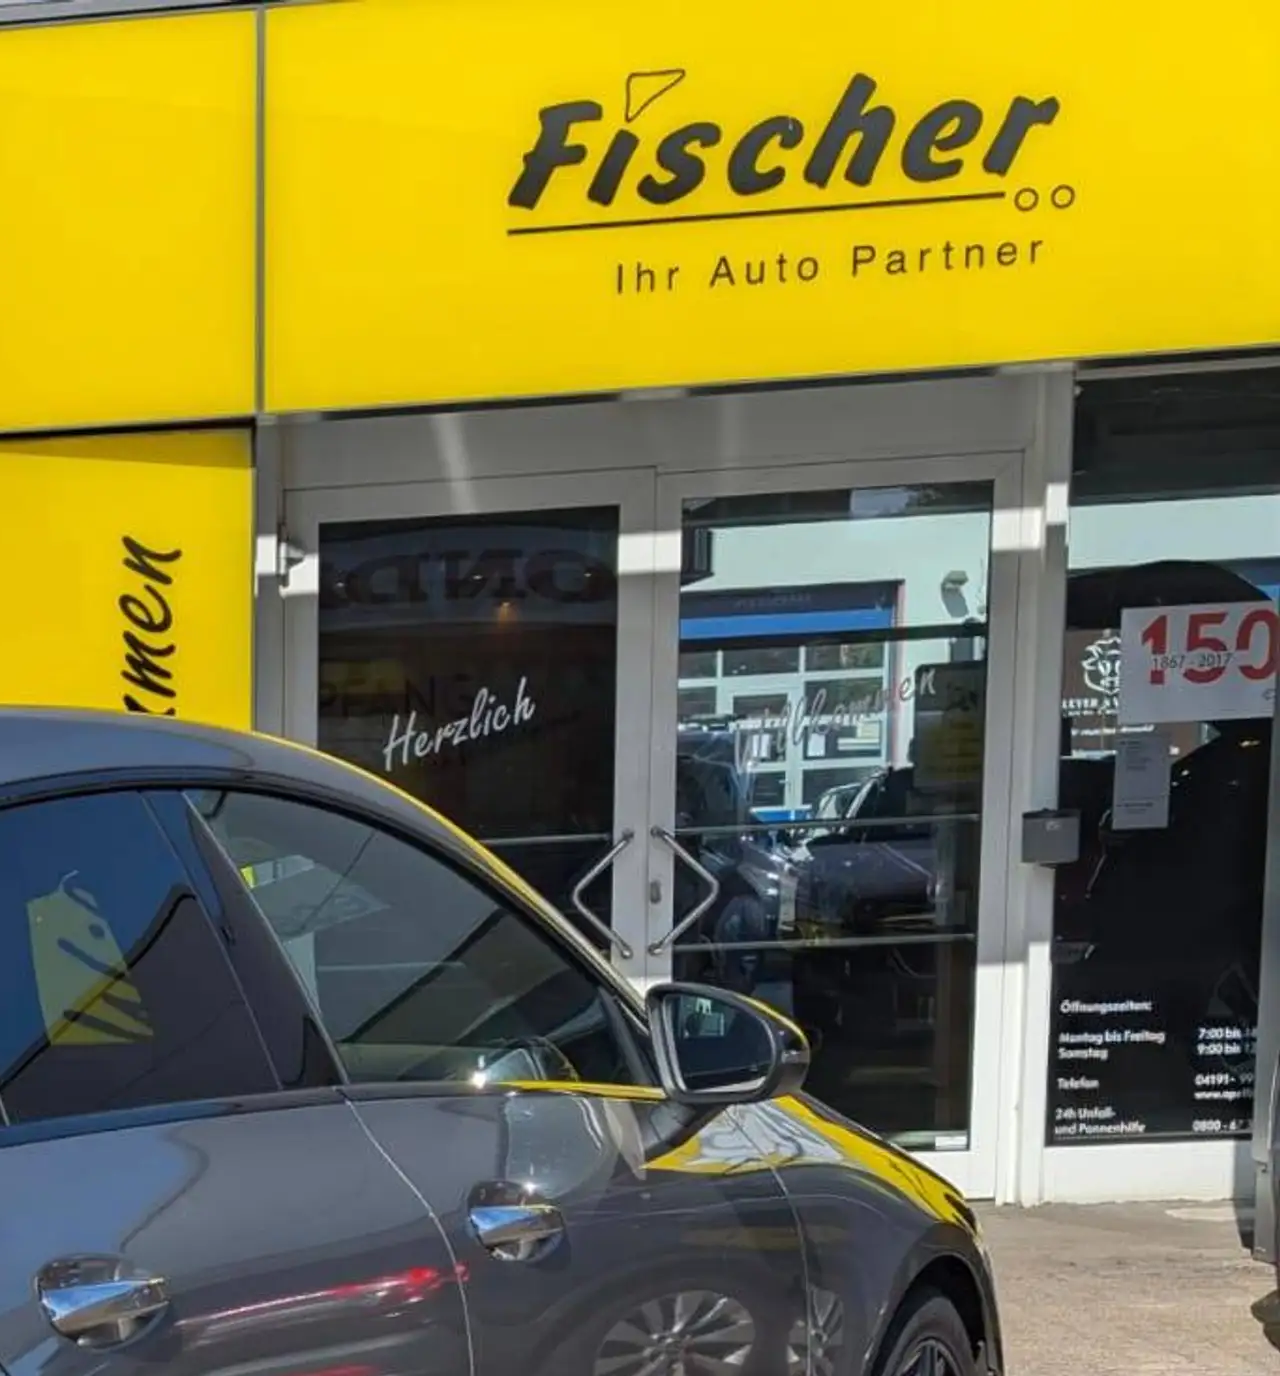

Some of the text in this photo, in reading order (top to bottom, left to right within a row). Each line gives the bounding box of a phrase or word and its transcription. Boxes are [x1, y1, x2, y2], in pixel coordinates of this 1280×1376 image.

[507, 70, 1060, 210] Fischer
[615, 236, 1044, 295] Ihr Auto Partner
[1141, 609, 1278, 685] 150
[1198, 652, 1234, 668] 2017
[382, 675, 537, 772] Herzlich
[1060, 999, 1152, 1015] Öffnungszeiten:
[1059, 1032, 1103, 1046] Montag
[1105, 1030, 1122, 1042] bis
[1124, 1030, 1166, 1044] Freitag
[1225, 1026, 1241, 1039] bis
[1058, 1047, 1108, 1061] Samstag
[1057, 1077, 1100, 1090] Telefon
[1055, 1123, 1077, 1135] und
[1079, 1120, 1146, 1134] Pannenhilfe
